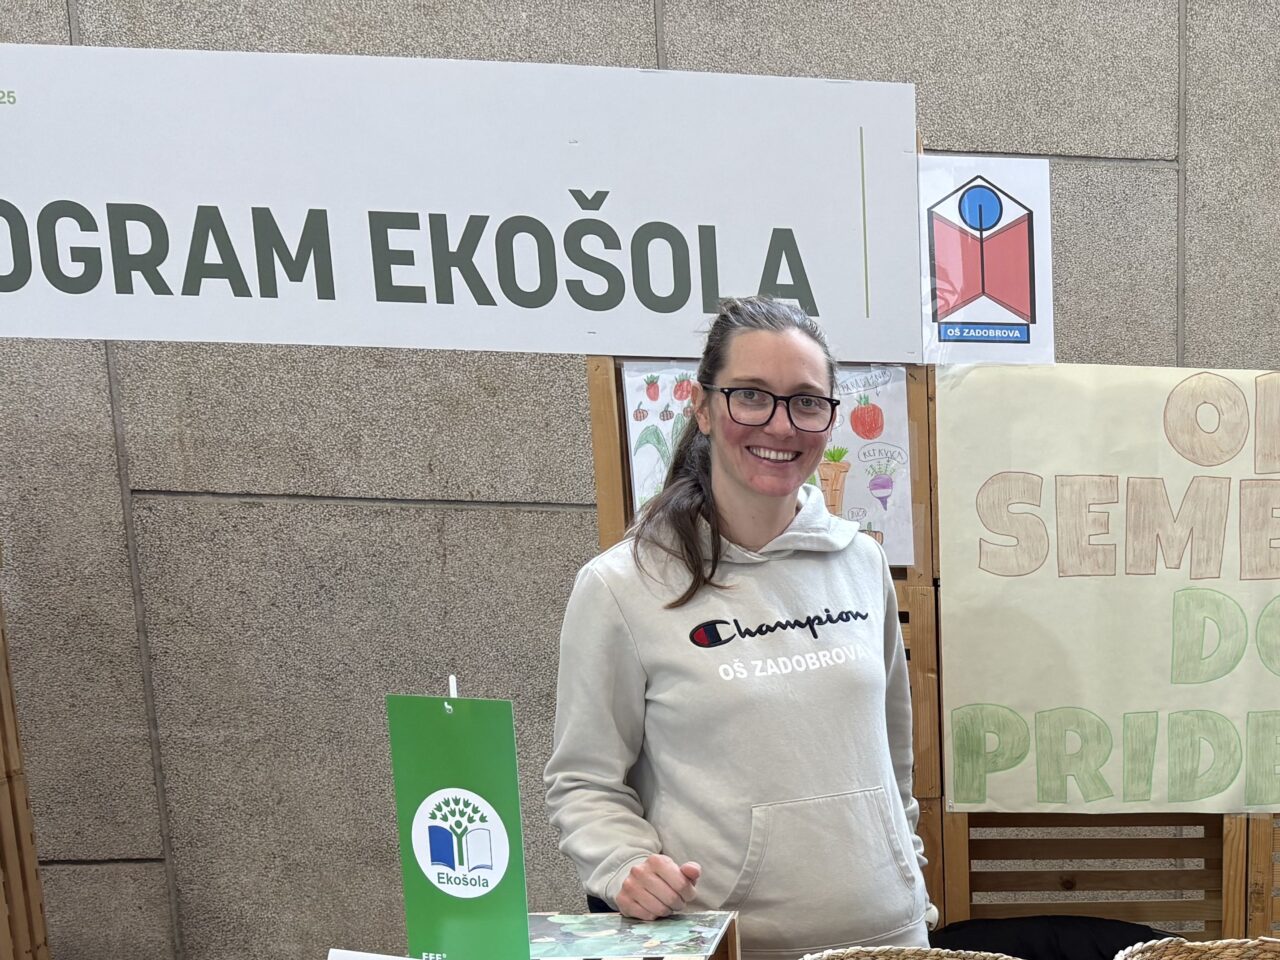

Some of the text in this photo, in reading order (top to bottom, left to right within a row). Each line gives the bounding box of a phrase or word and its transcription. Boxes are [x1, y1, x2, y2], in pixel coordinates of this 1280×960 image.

[367, 188, 822, 318] EKOŠOLA
[947, 327, 1021, 338] OŠ ZADOBROVA
[689, 608, 869, 648] Champion
[718, 658, 748, 681] OŠ
[437, 872, 489, 888] Ekošola
